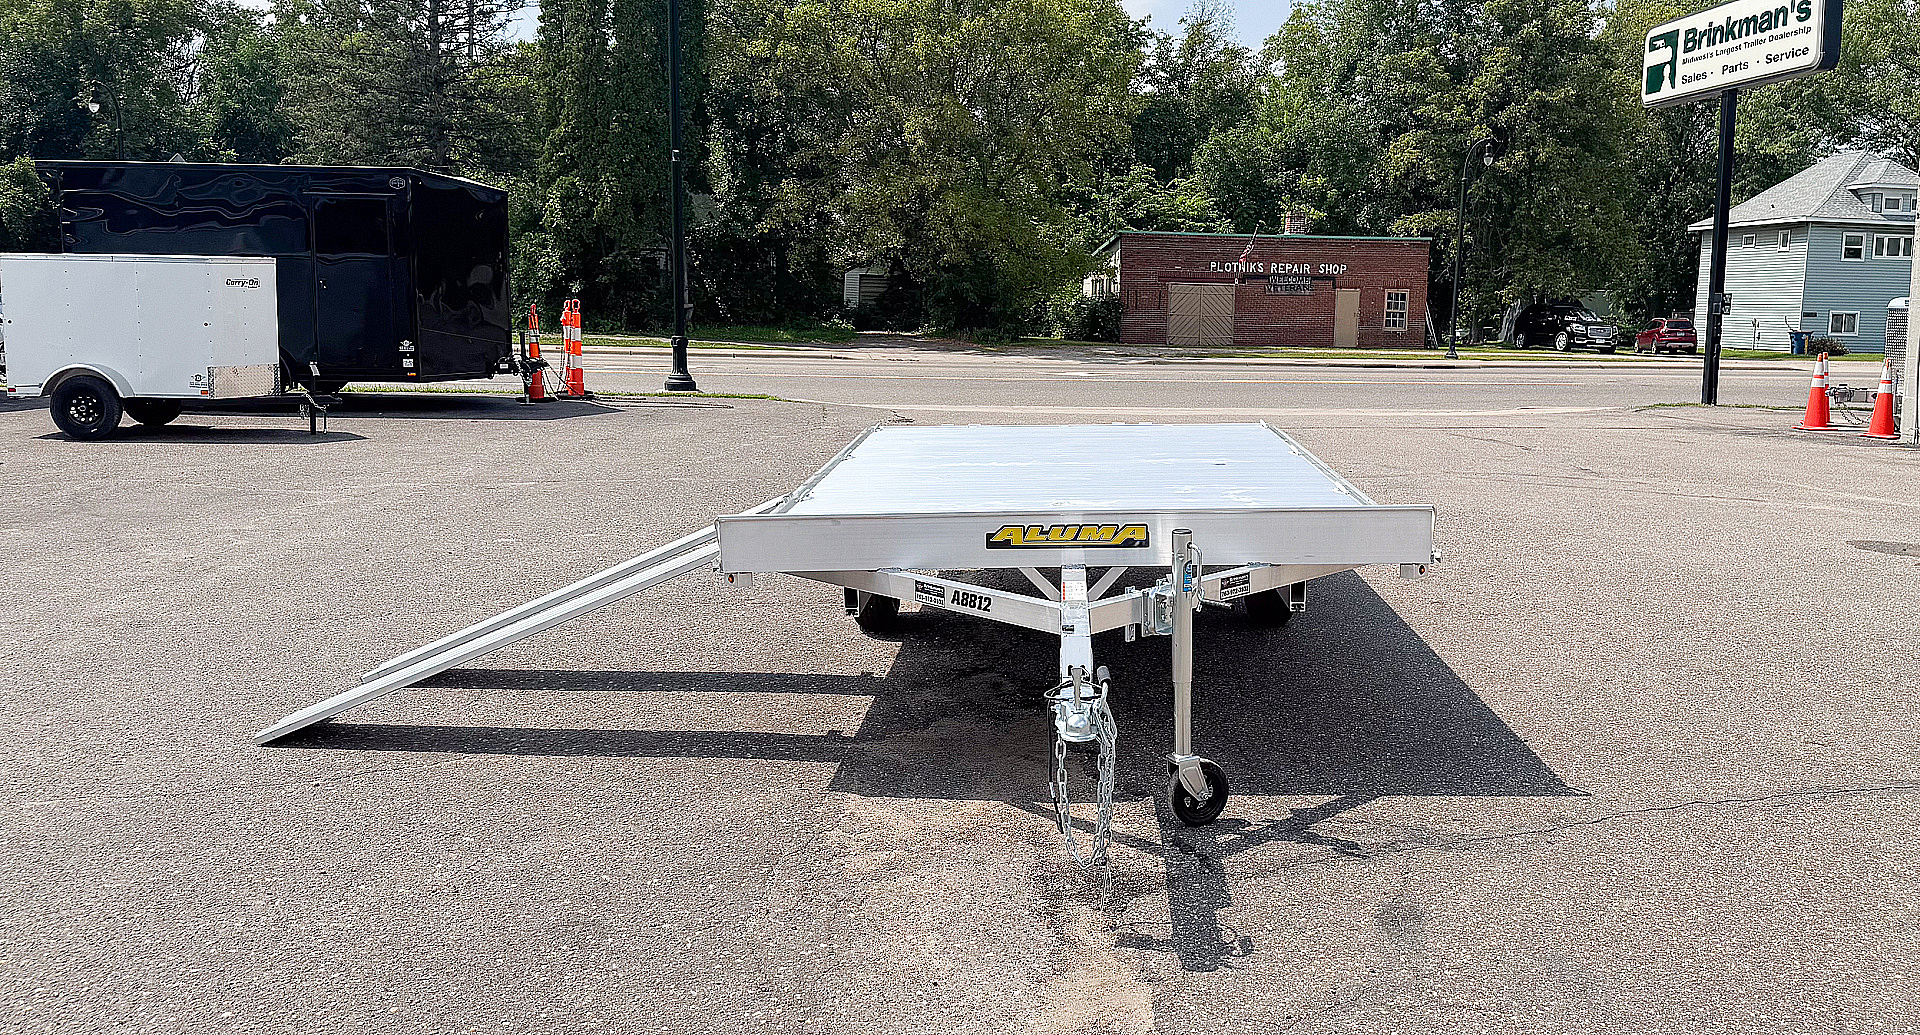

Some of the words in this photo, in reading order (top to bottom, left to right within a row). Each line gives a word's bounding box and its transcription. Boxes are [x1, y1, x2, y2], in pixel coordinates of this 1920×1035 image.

[1683, 0, 1812, 54] Brinkman's
[1682, 52, 1714, 65] Midwest's
[1716, 44, 1742, 57] Largest
[1744, 37, 1767, 49] Trailer
[1769, 26, 1812, 42] Dealership
[1681, 71, 1708, 85] Sales
[1722, 61, 1749, 75] Parts
[1765, 46, 1810, 64] Service
[1210, 261, 1264, 273] PLOTNIK'S
[1270, 262, 1311, 274] REPAIR
[1318, 263, 1348, 275] SHOP
[226, 278, 259, 288] Carry-On
[989, 525, 1147, 545] ALUMA
